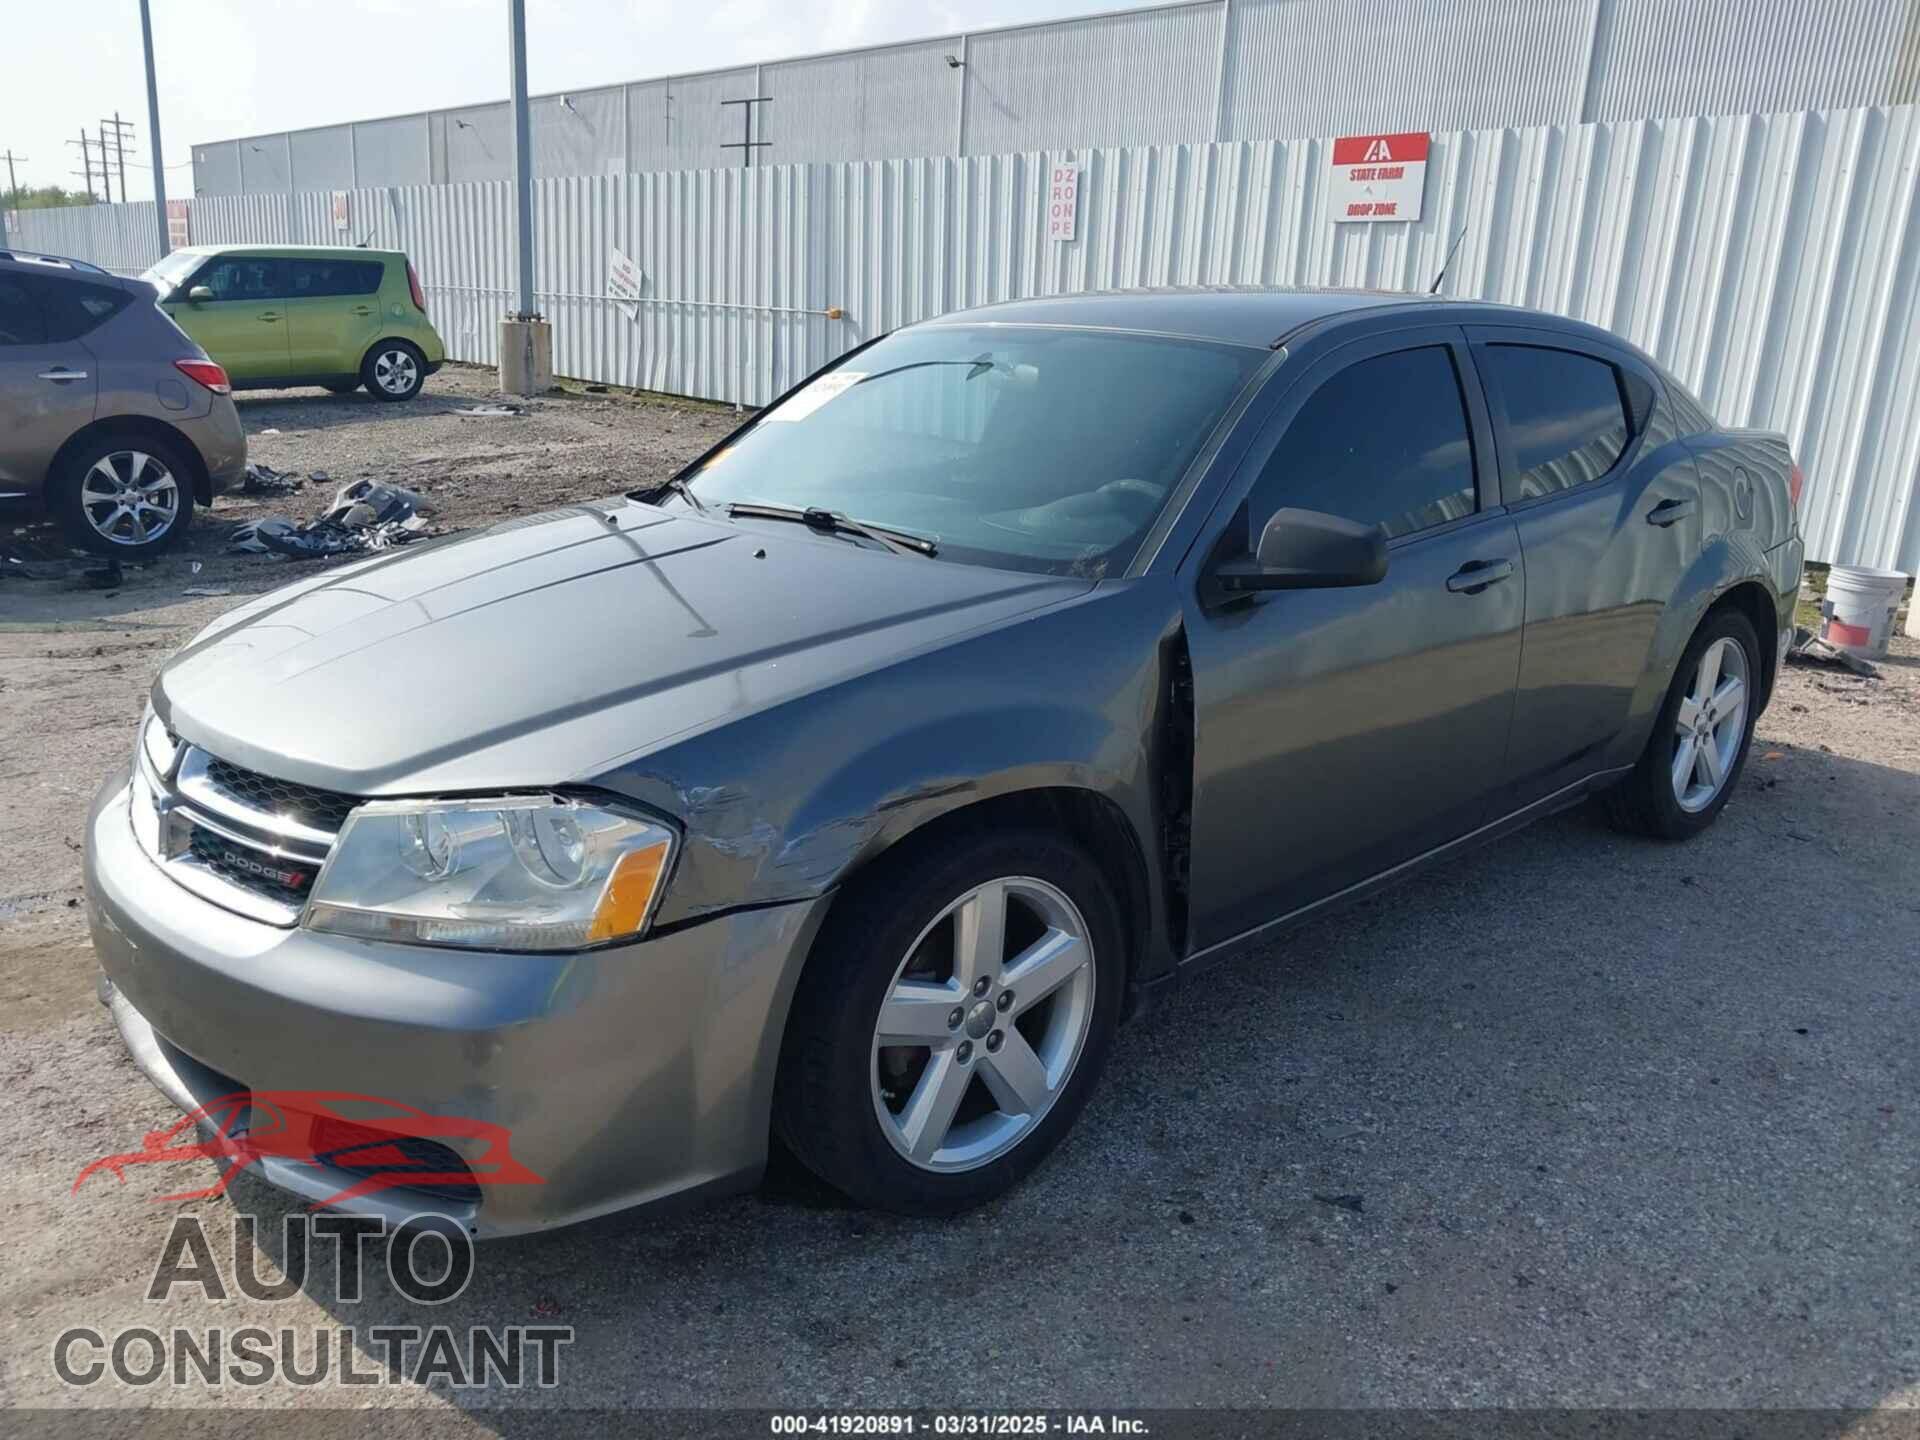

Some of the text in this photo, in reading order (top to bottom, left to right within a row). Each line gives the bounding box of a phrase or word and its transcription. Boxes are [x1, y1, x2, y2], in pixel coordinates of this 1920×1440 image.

[1350, 166, 1404, 182] STATE FARM
[1347, 202, 1397, 217] DROP ZONE
[224, 851, 292, 884] DODGE
